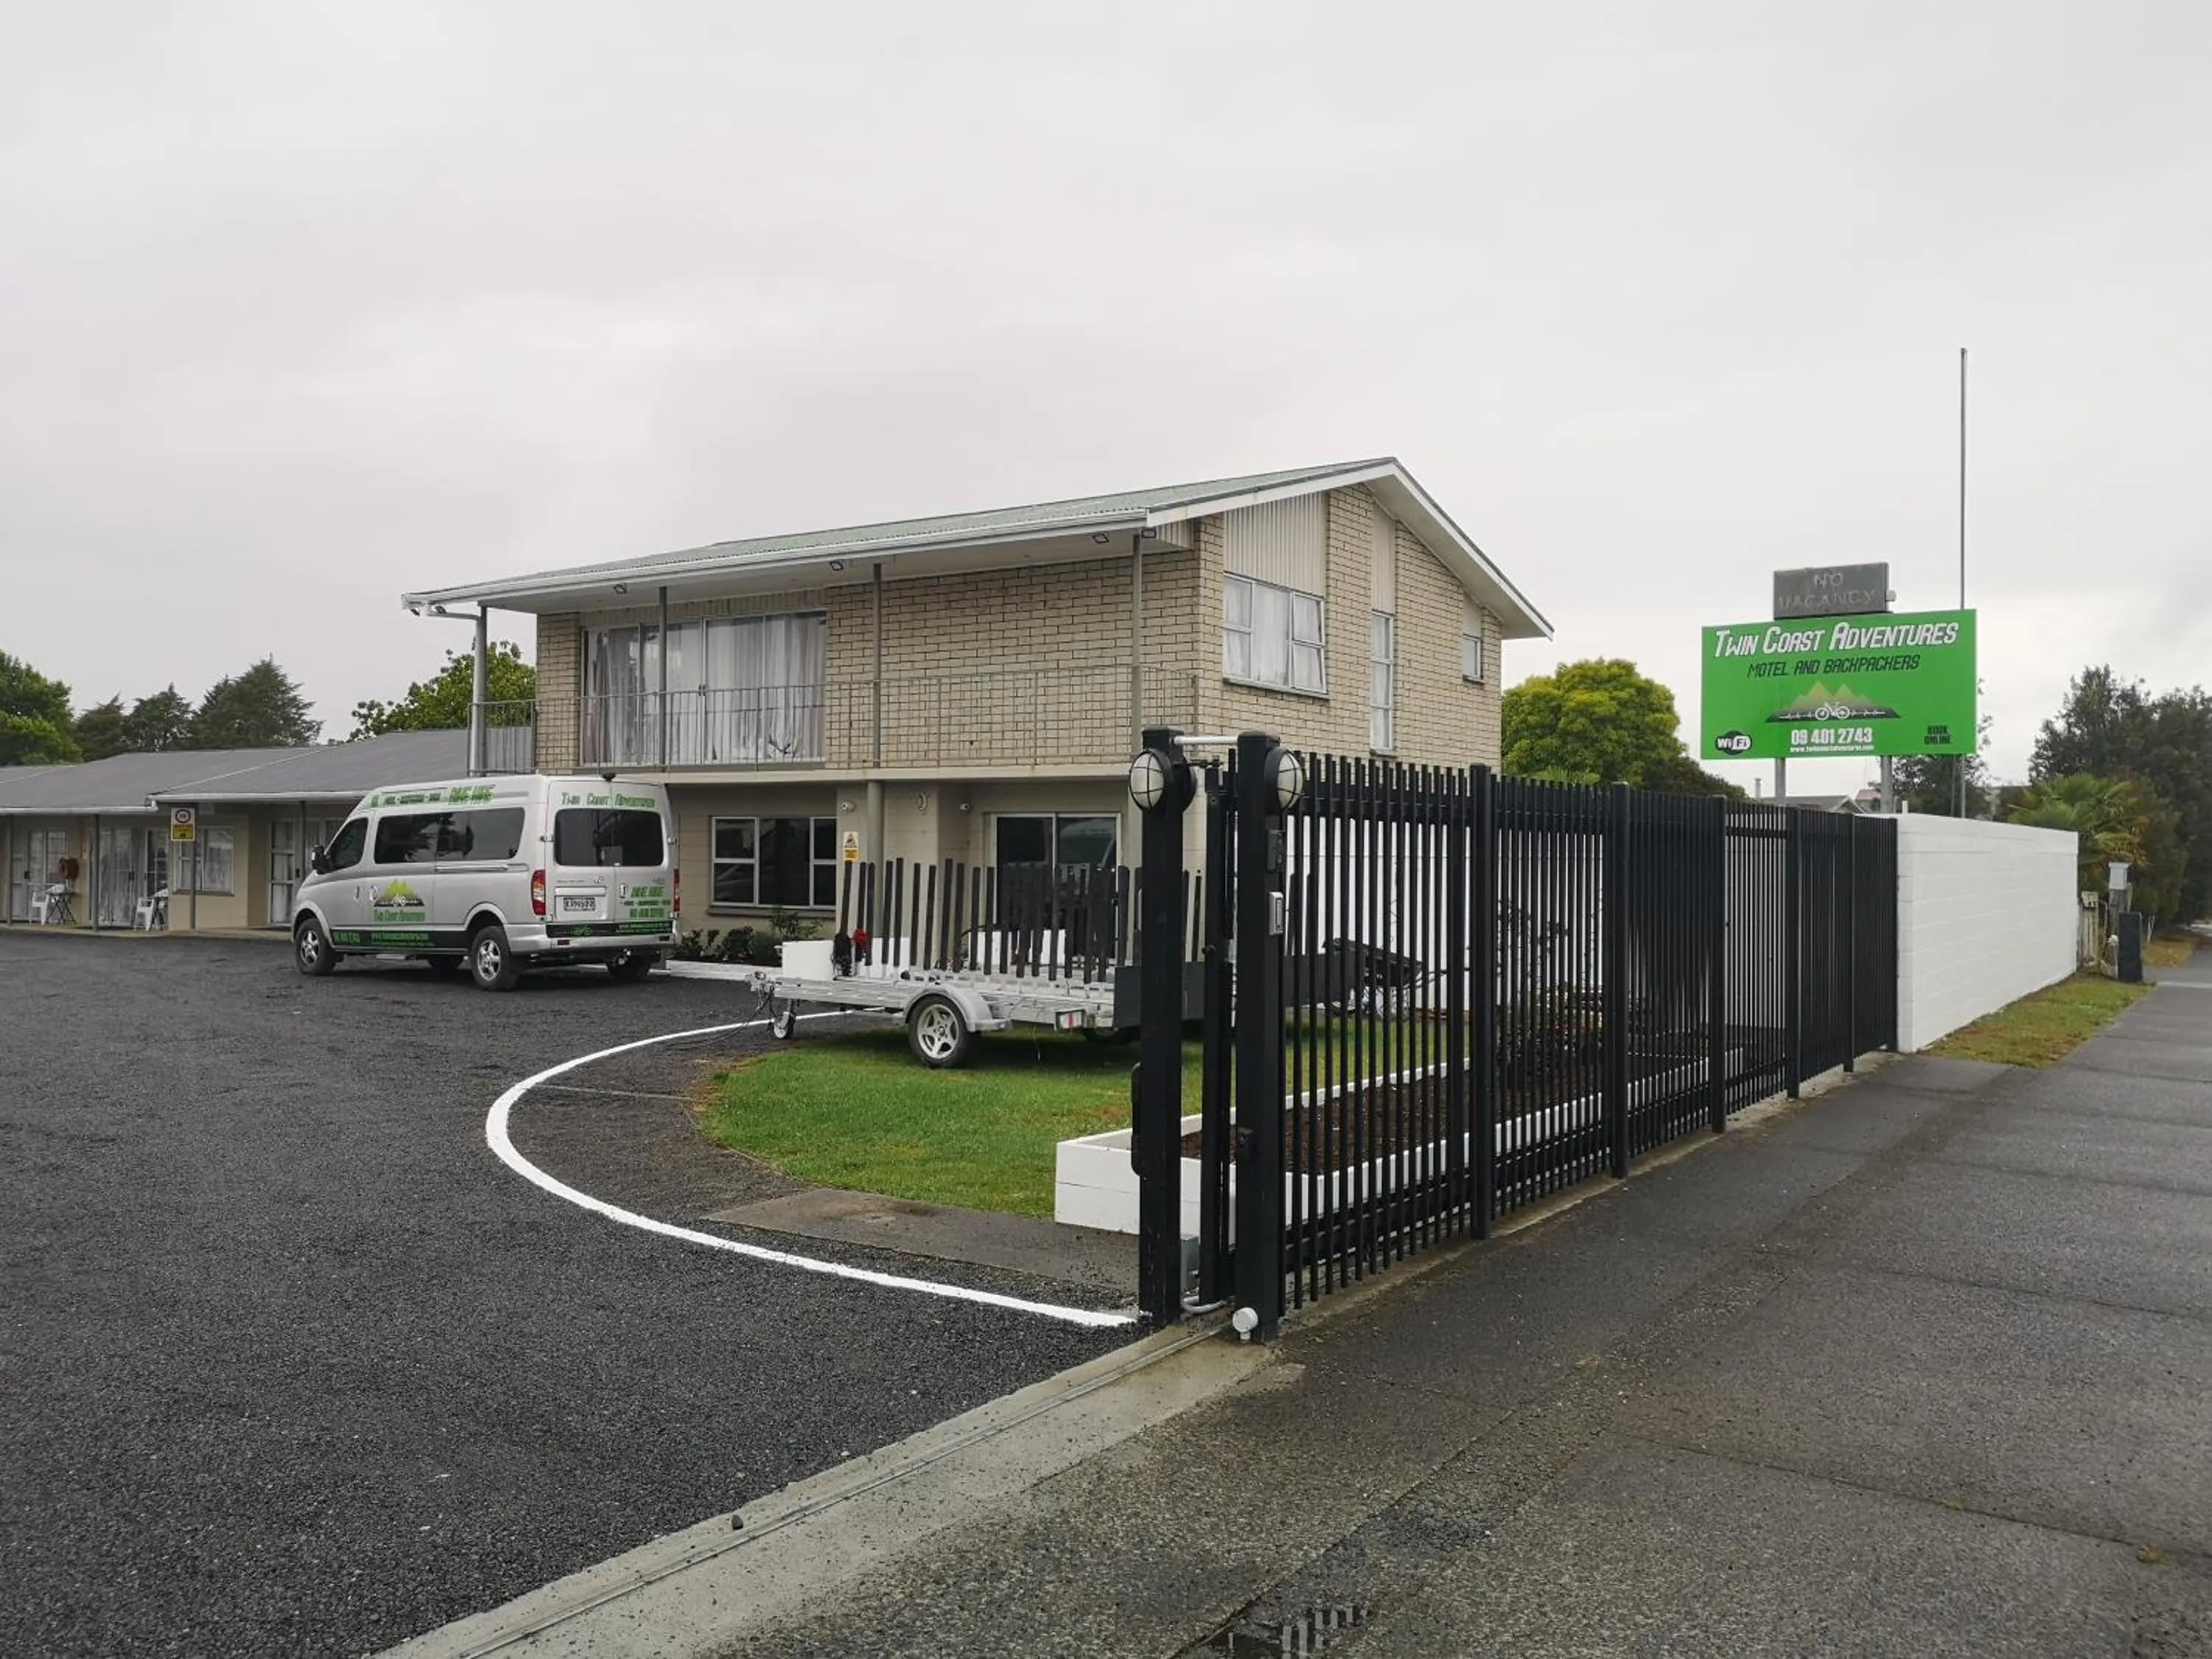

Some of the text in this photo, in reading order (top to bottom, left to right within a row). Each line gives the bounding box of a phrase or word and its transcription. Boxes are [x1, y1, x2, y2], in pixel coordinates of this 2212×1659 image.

[1814, 573, 1843, 588] NO
[1778, 590, 1877, 608] VACANCY
[1747, 654, 1921, 678] MOTEL AND BACKPACKERS
[1791, 727, 1873, 745] 09 401 2743
